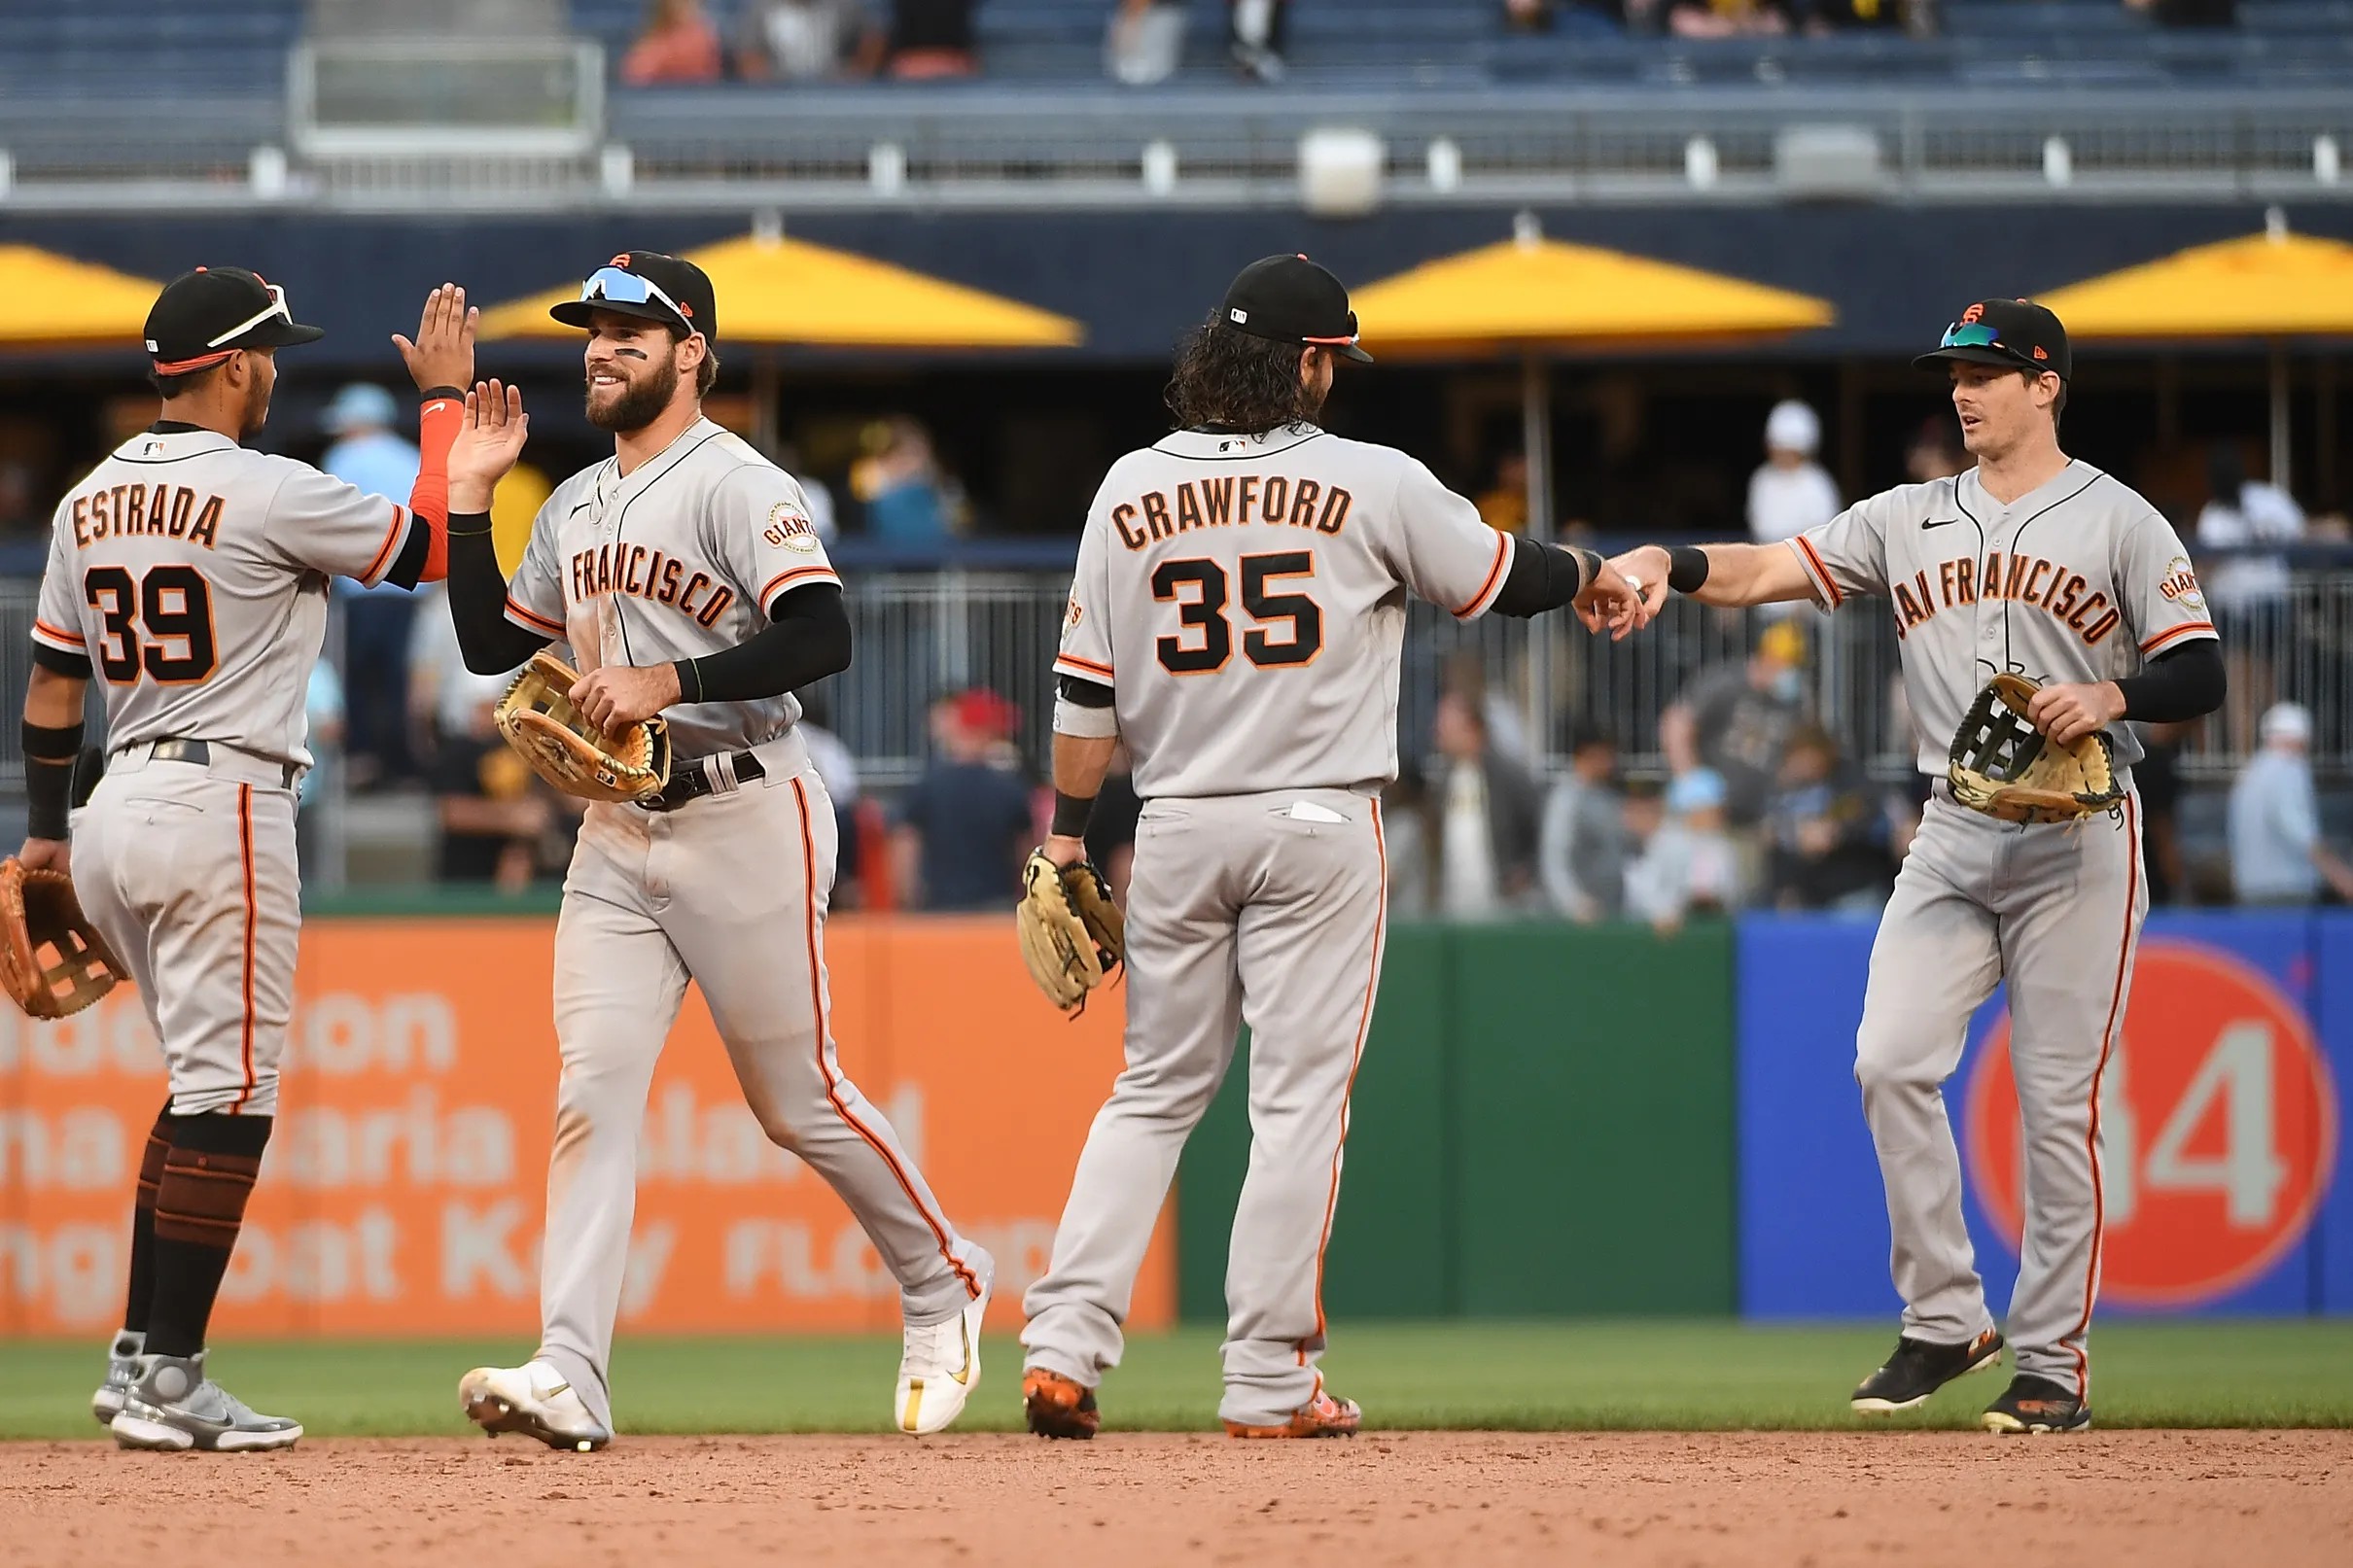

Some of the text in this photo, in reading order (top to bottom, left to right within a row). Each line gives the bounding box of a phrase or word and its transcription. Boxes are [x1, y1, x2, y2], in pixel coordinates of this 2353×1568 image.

[72, 484, 226, 550] ESTRADA
[1111, 475, 1352, 551] CRAWFORD
[84, 565, 221, 686] 39
[572, 541, 735, 630] FRANCISCO
[1150, 549, 1324, 676] 35
[1938, 551, 2121, 646] FRANCISCO
